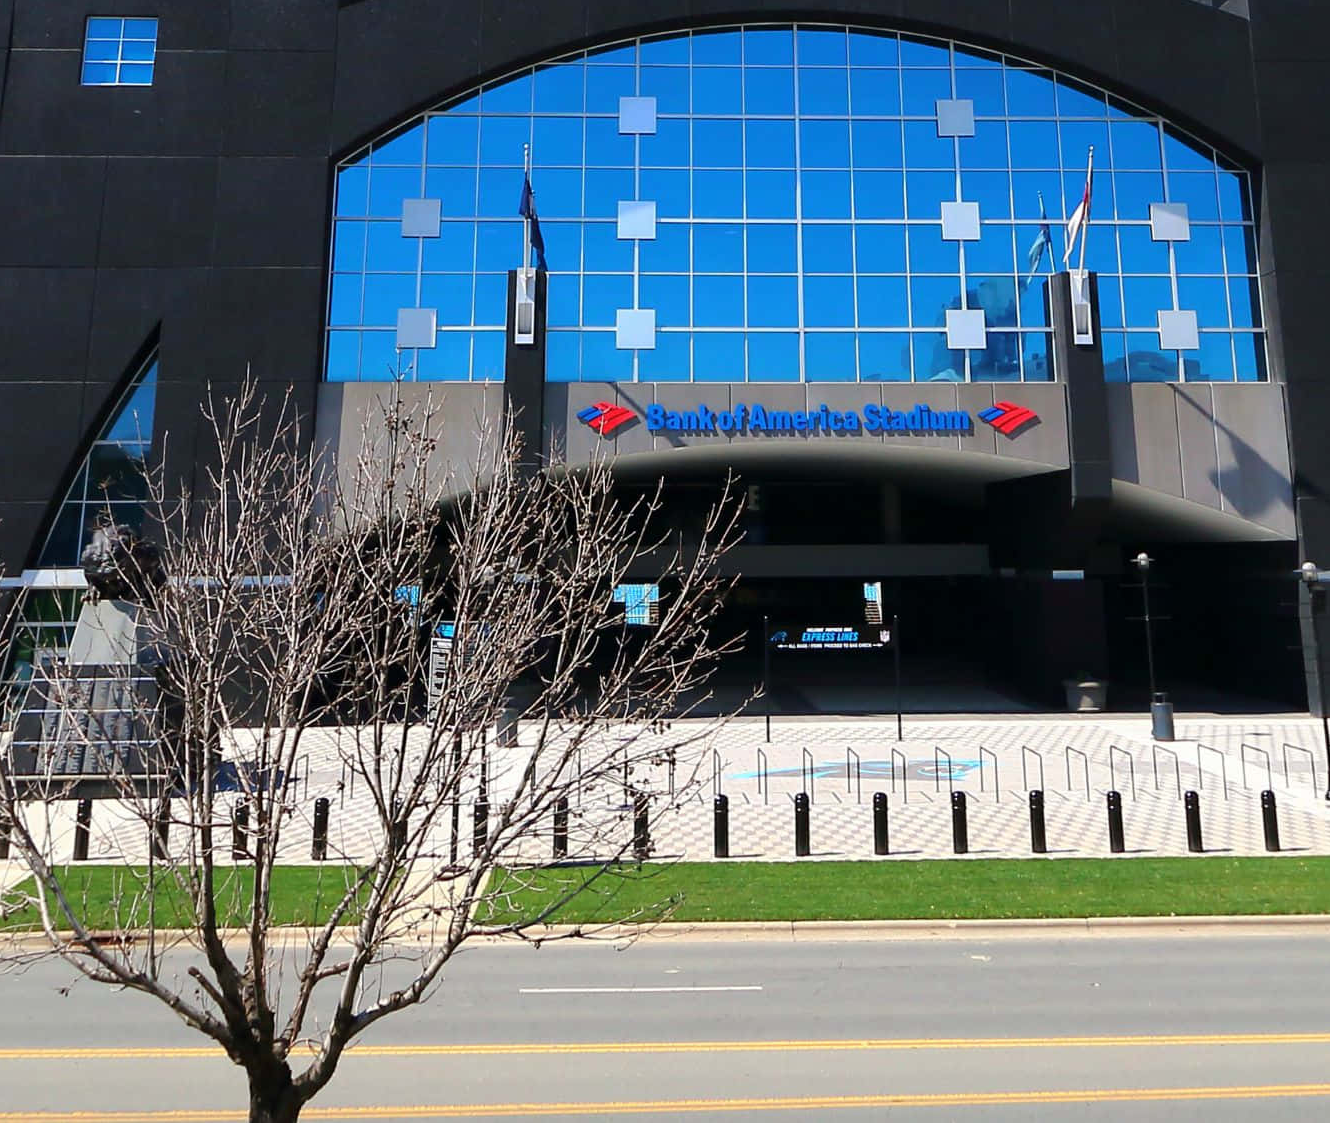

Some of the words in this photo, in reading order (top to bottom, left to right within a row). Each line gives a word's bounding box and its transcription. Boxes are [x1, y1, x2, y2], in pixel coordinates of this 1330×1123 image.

[646, 403, 716, 431] Bank
[717, 403, 746, 430] of
[748, 404, 860, 431] America
[863, 403, 970, 431] Stadium
